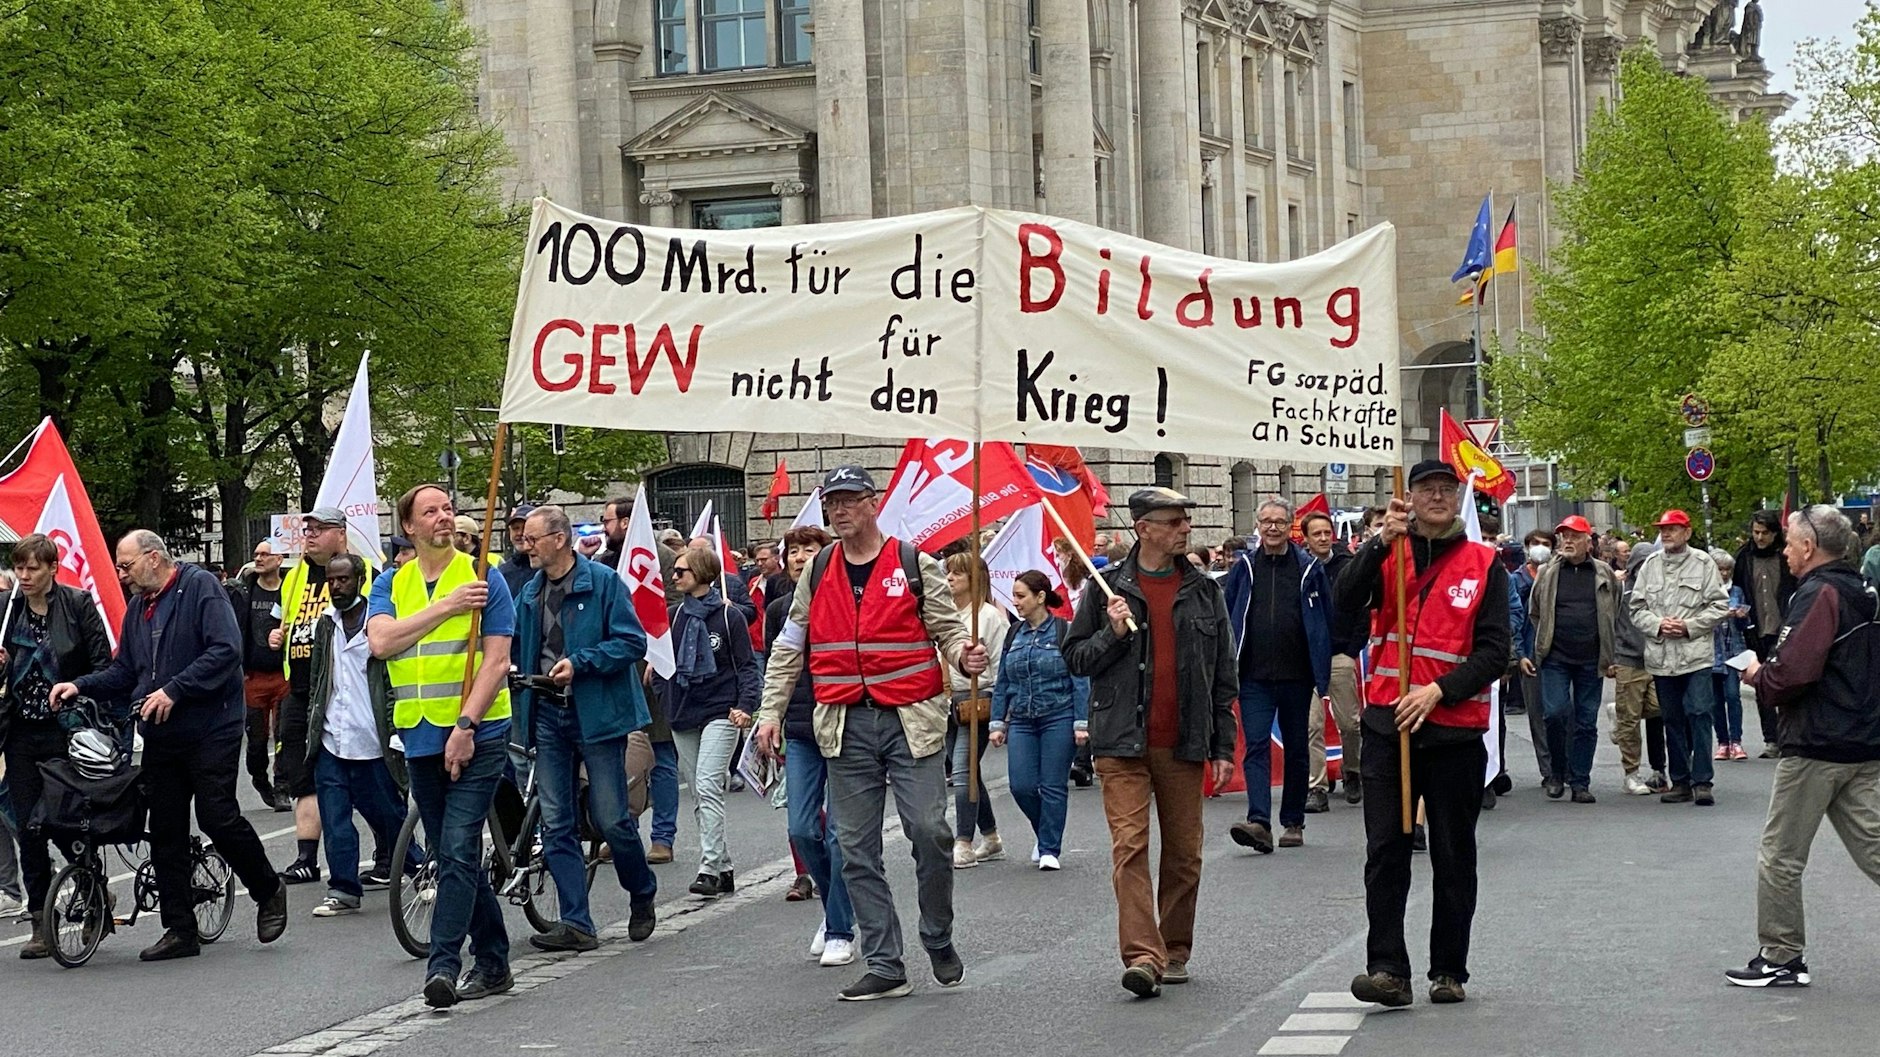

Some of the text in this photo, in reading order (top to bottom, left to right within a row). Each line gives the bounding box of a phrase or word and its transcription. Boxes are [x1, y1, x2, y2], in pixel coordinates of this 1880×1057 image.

[537, 221, 1361, 349] 100 Mrd. für die Bildung
[878, 313, 943, 360] für
[532, 318, 704, 396] GEW
[731, 356, 834, 402] nicht
[870, 367, 938, 415] den
[1247, 359, 1286, 386] FG
[1272, 396, 1397, 428] Fachkräfte
[1252, 421, 1394, 451] an Schulen
[1447, 585, 1478, 600] GEW
